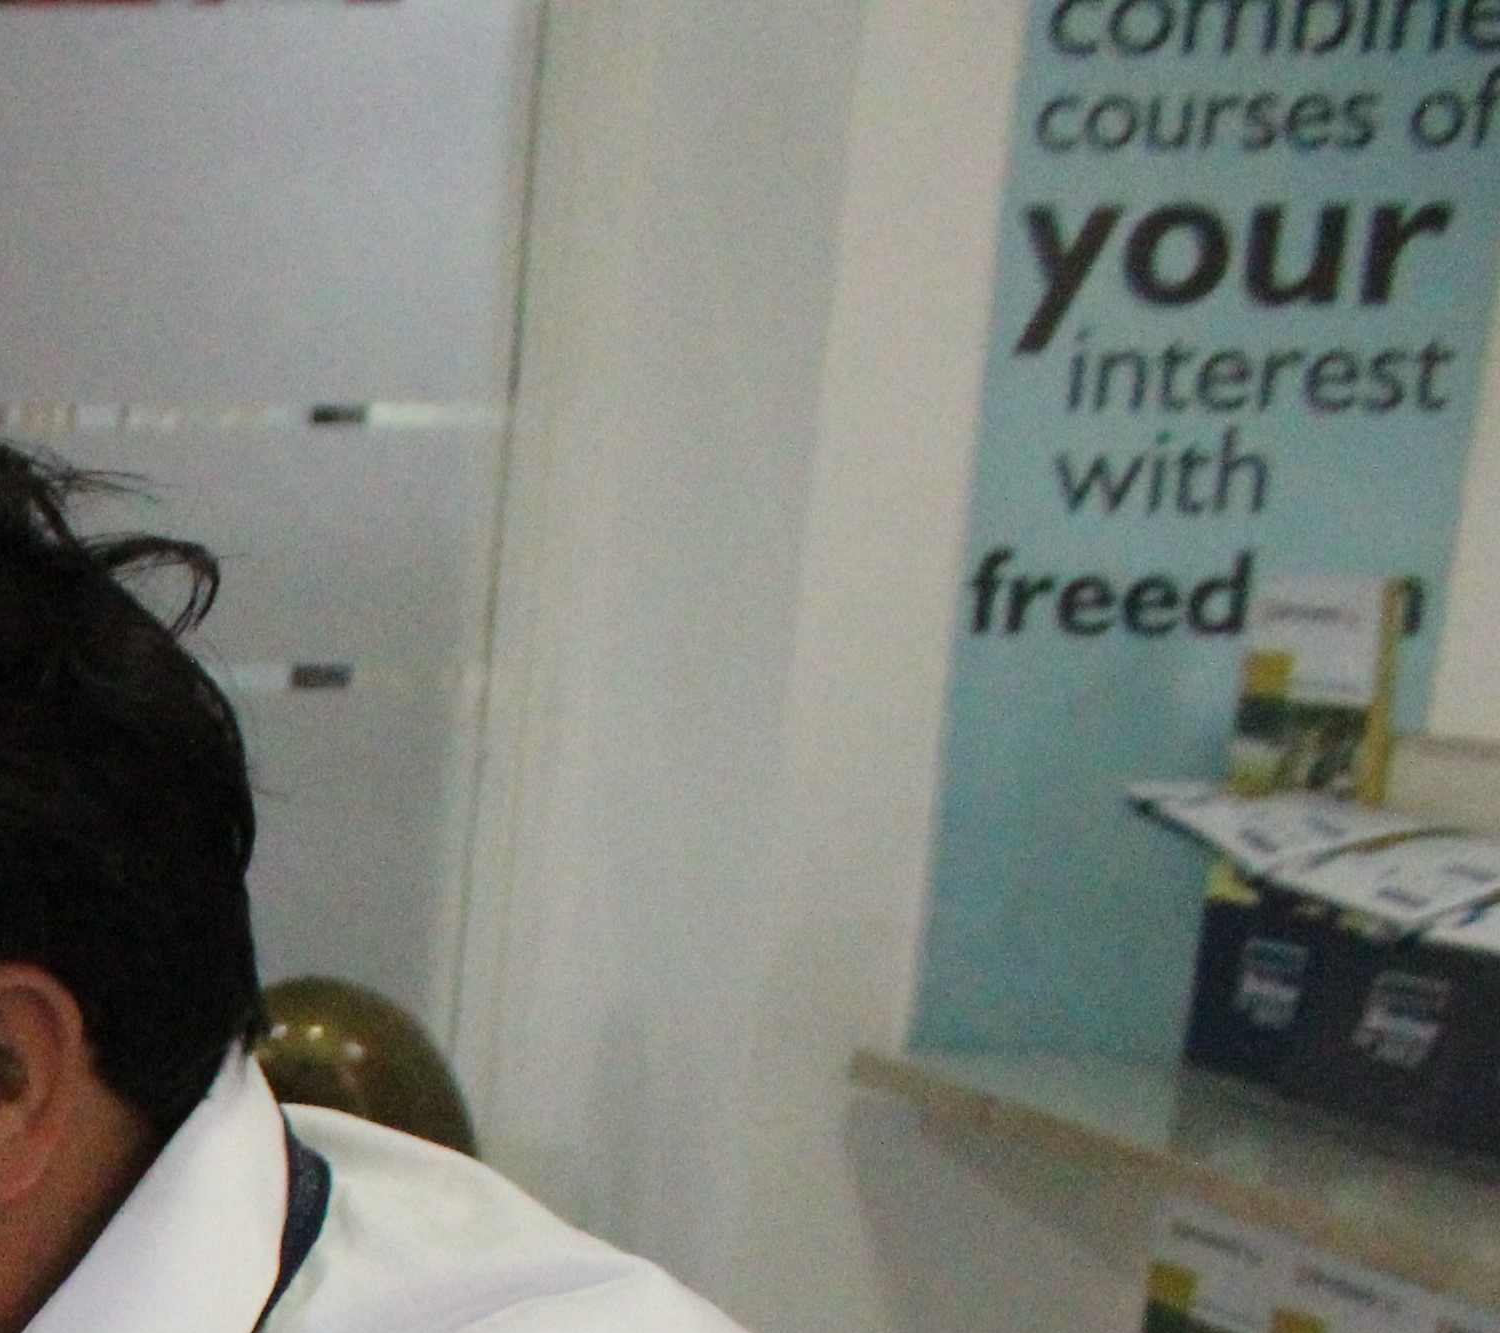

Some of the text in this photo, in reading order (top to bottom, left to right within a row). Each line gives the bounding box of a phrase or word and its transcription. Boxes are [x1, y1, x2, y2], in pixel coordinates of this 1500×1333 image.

[1035, 66, 1500, 153] courses of
[1014, 201, 1453, 354] your
[1066, 327, 1455, 412] interest
[1054, 425, 1269, 515] with
[969, 546, 1424, 636] freed
